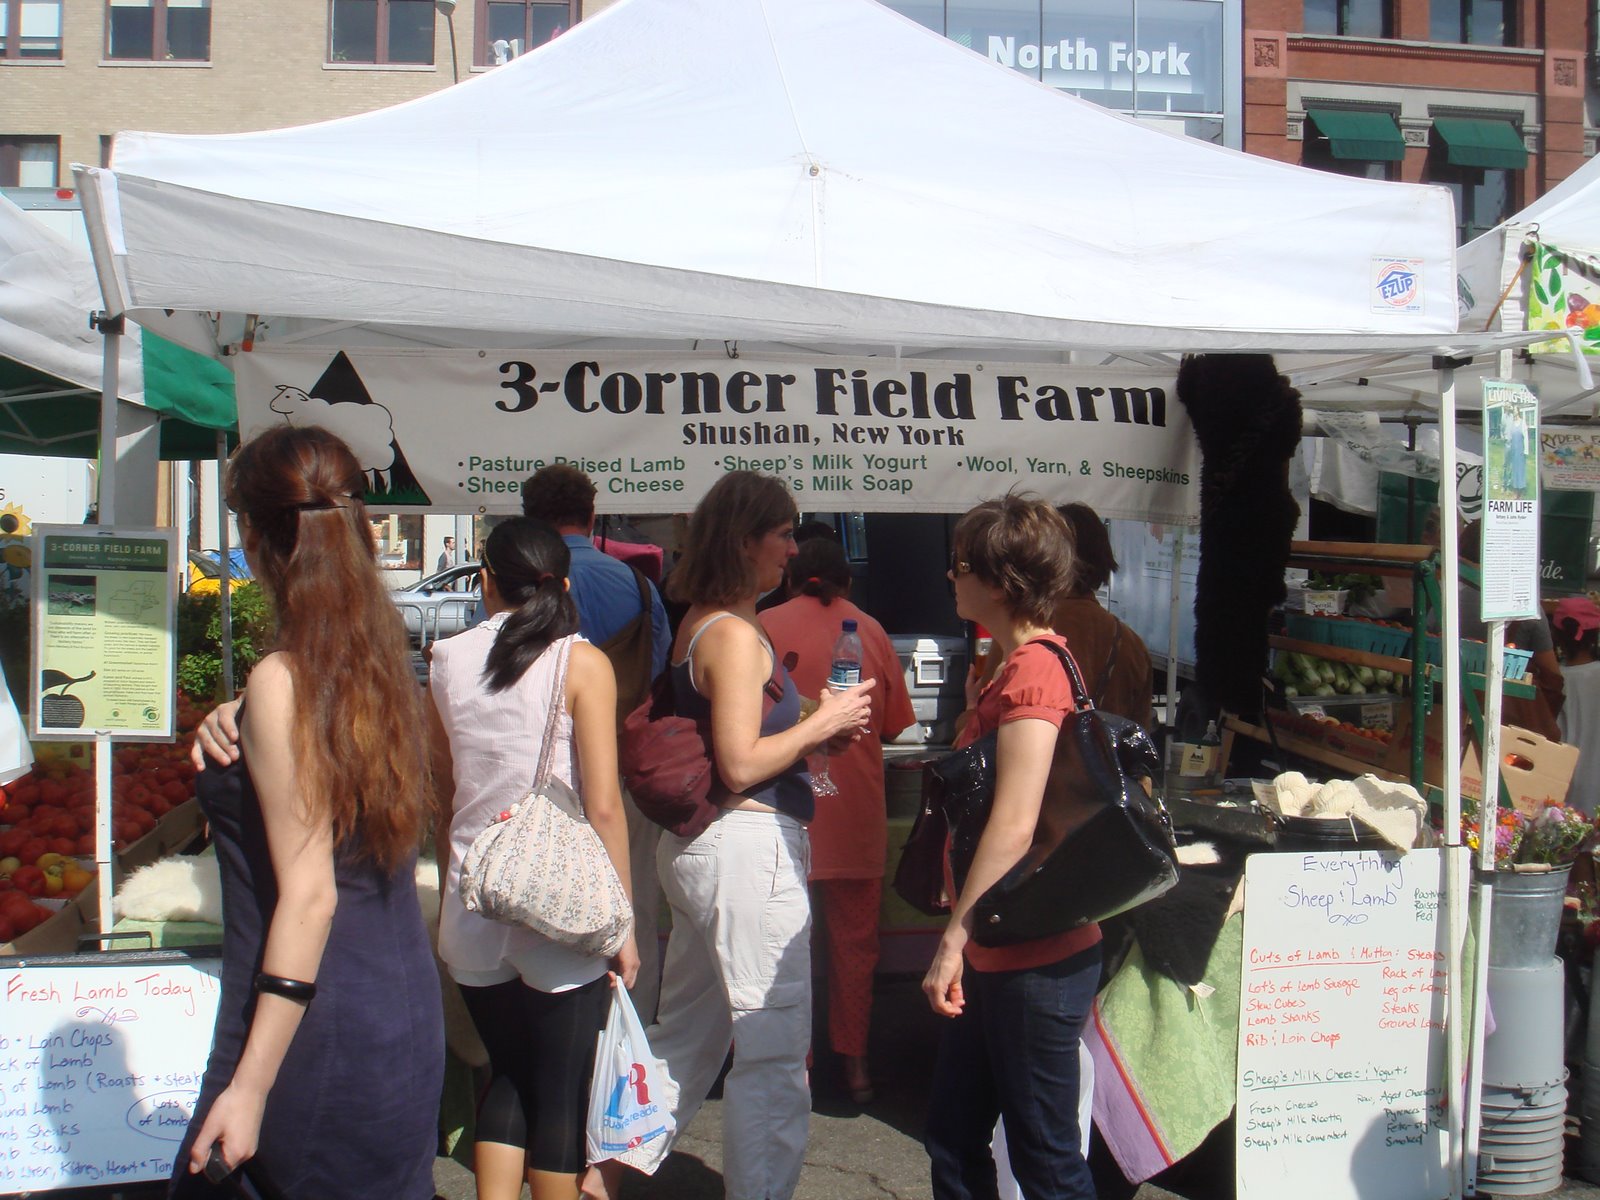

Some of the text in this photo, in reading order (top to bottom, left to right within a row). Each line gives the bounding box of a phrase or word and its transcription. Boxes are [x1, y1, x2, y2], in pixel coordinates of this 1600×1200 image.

[988, 36, 1191, 76] North Fork
[495, 361, 1166, 427] 3-Corner Field Farm
[682, 421, 965, 446] Shushan, New York
[1541, 433, 1585, 452] RYDER
[469, 456, 545, 472] Pasture
[630, 456, 685, 472] Lamb
[723, 454, 928, 474] Sheep's Milk Yogurt
[966, 456, 1190, 485] Wool, Yarn, & Sheepskins
[608, 477, 685, 493] Cheese
[812, 475, 853, 491] Milk
[863, 475, 913, 494] Soap
[1489, 501, 1532, 513] FARM LIFE
[51, 543, 161, 555] 3-CORNER FIELD FARM
[1303, 853, 1403, 889] Everything
[1284, 885, 1334, 915] Sheep
[1352, 888, 1398, 906] Lamb
[1287, 950, 1302, 961] of
[1308, 950, 1340, 960] Lamb
[1382, 966, 1407, 980] Rack
[1411, 968, 1424, 979] of
[1280, 980, 1293, 992] of
[1402, 985, 1416, 995] of
[7, 973, 61, 1003] Fresh
[74, 980, 128, 1002] Lamb
[135, 973, 195, 1017] Today
[1274, 997, 1306, 1009] Cubes
[1382, 1003, 1420, 1014] Steaks
[1247, 1011, 1321, 1026] Lamb Shanks
[1379, 1016, 1416, 1030] Ground
[29, 1033, 64, 1049] Loin
[71, 1028, 113, 1056] Chops
[1246, 1033, 1268, 1047] Rib
[1282, 1033, 1306, 1044] Loin
[1311, 1031, 1341, 1049] Chops
[25, 1056, 41, 1070] of
[50, 1053, 94, 1070] Lamb
[13, 1077, 28, 1093] of
[37, 1074, 77, 1090] Lamb
[1243, 1069, 1288, 1090] Sheep's
[1292, 1067, 1322, 1082] Milk
[33, 1098, 74, 1116] Lamb
[152, 1098, 180, 1109] Lots
[1250, 1101, 1280, 1114] Fresh
[139, 1114, 153, 1126] of
[1246, 1118, 1281, 1132] Sheep's
[1287, 1115, 1307, 1126] Milk
[1243, 1136, 1278, 1152] Sheep's
[1282, 1134, 1303, 1145] Milk
[1385, 1134, 1423, 1147] Smoked
[150, 1158, 173, 1173] Ton
